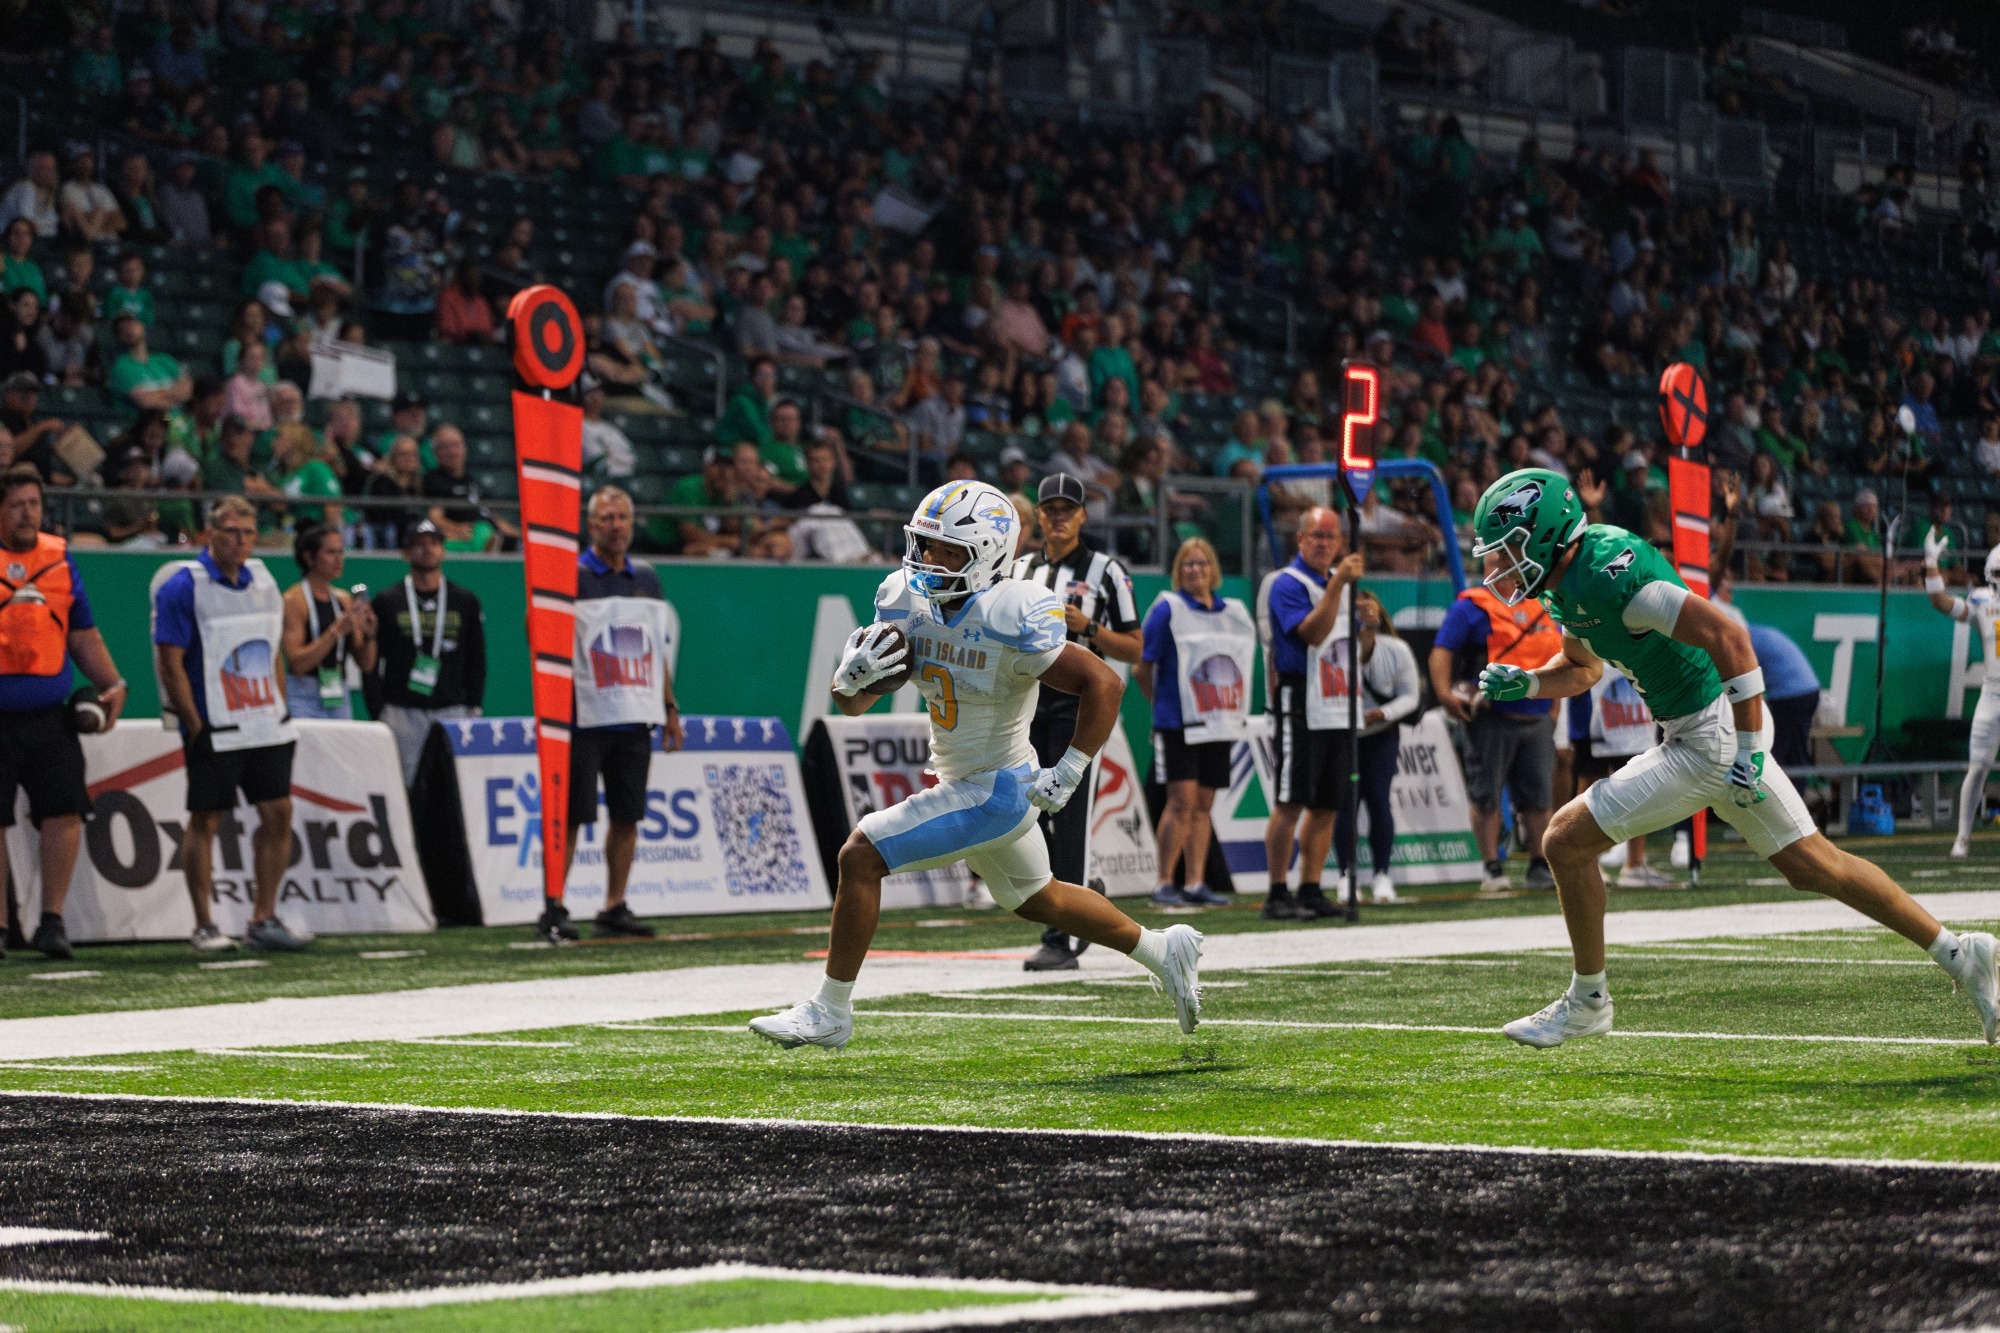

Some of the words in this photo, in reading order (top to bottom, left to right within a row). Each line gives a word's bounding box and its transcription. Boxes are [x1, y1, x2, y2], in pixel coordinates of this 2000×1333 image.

[1343, 367, 1378, 469] 2
[916, 519, 940, 531] Riddell
[935, 640, 987, 670] ISLAND
[921, 660, 959, 733] 3
[844, 739, 932, 765] POW
